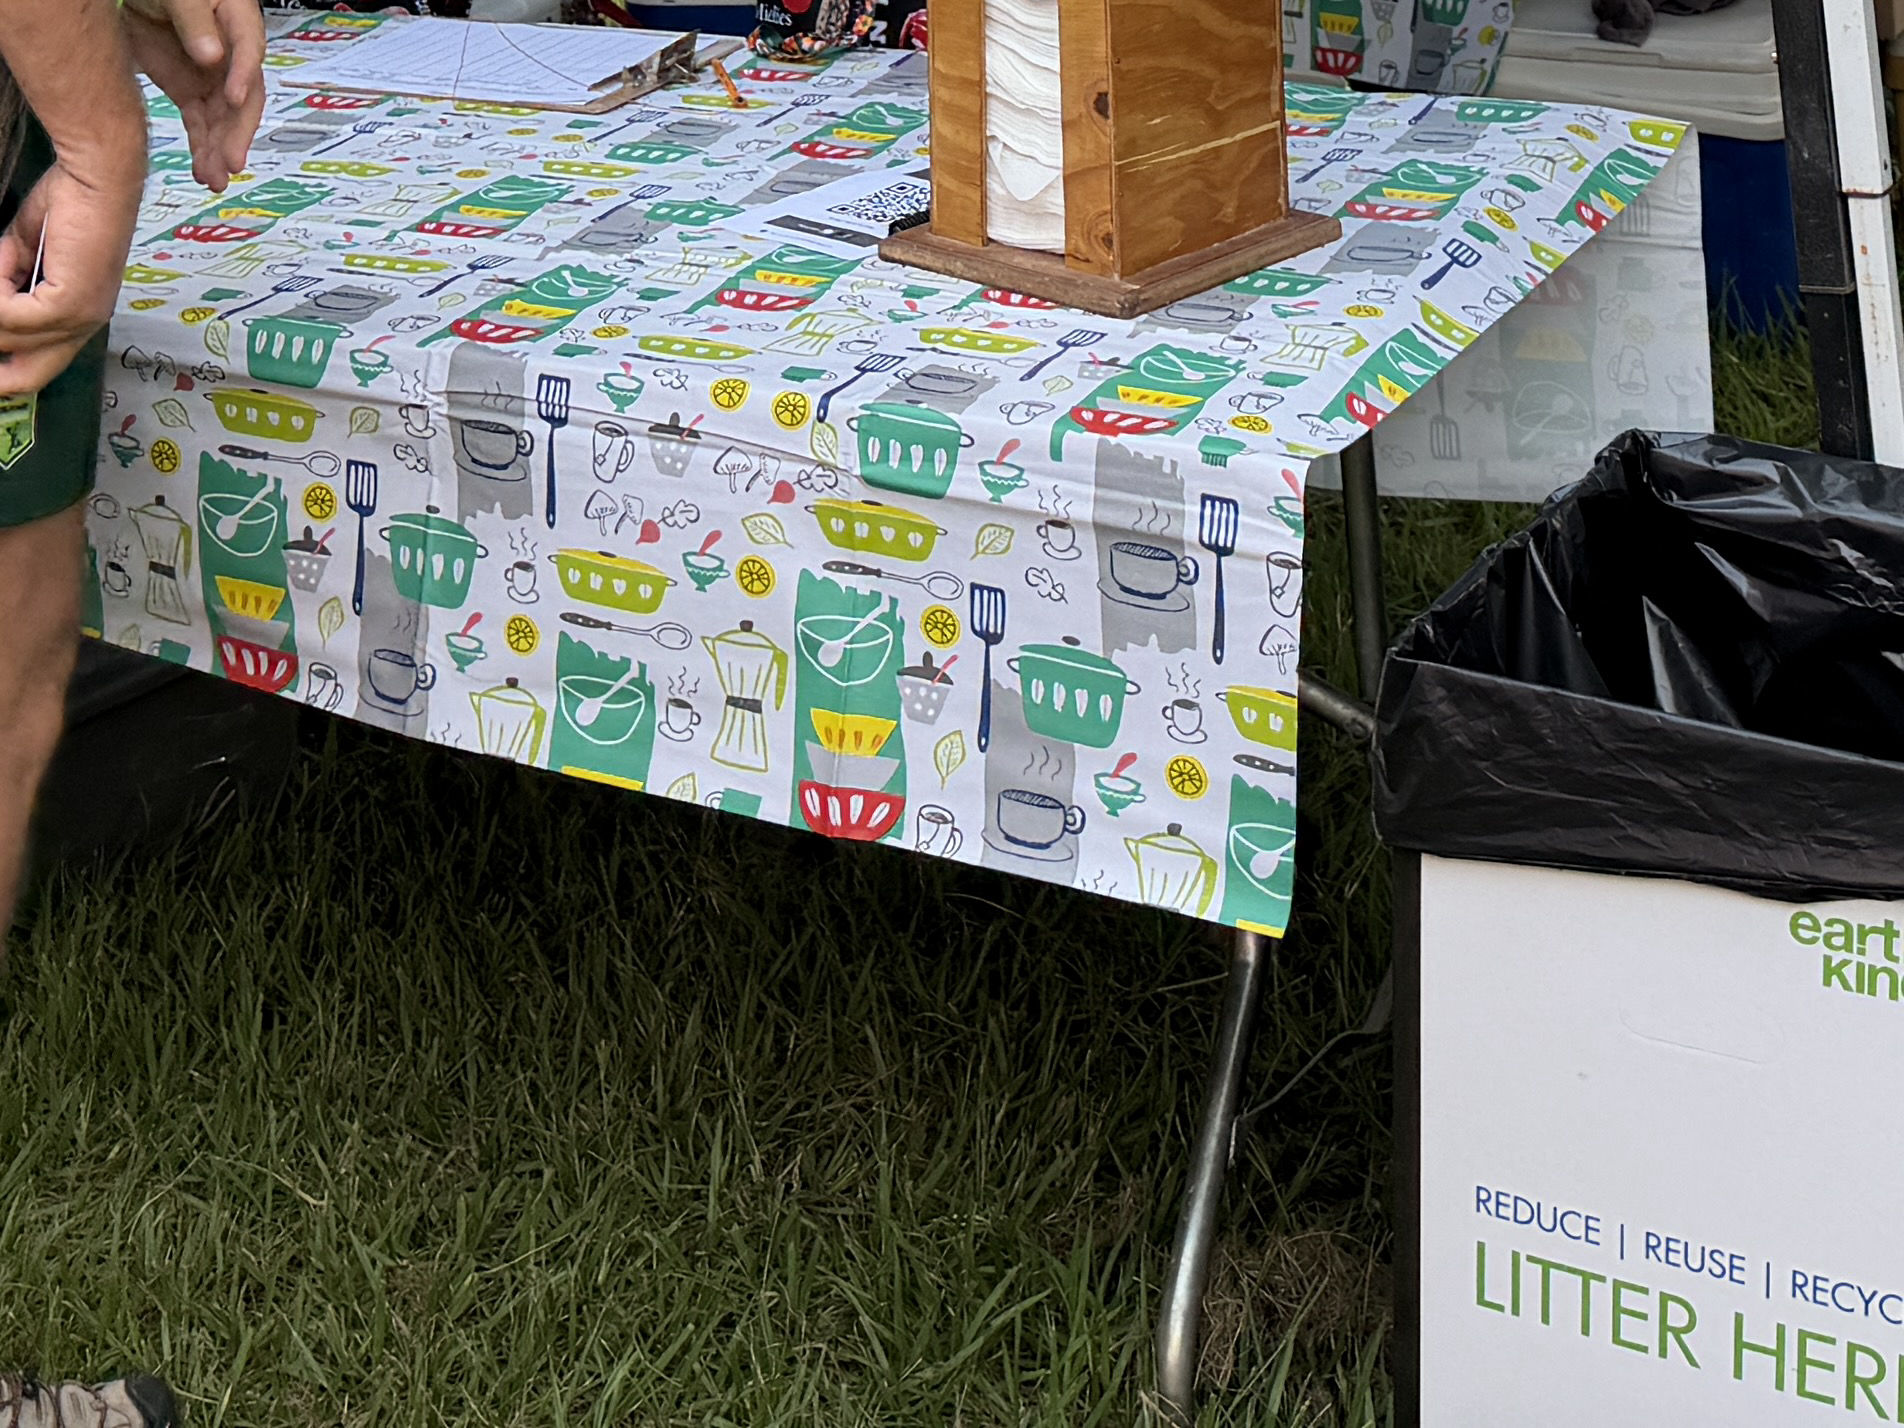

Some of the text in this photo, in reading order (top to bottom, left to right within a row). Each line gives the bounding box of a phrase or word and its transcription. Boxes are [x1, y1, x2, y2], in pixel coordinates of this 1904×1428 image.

[1474, 1185, 1601, 1247] REDUCE
[1645, 1231, 1746, 1287] REUSE
[1475, 1240, 1701, 1370] LITTER
